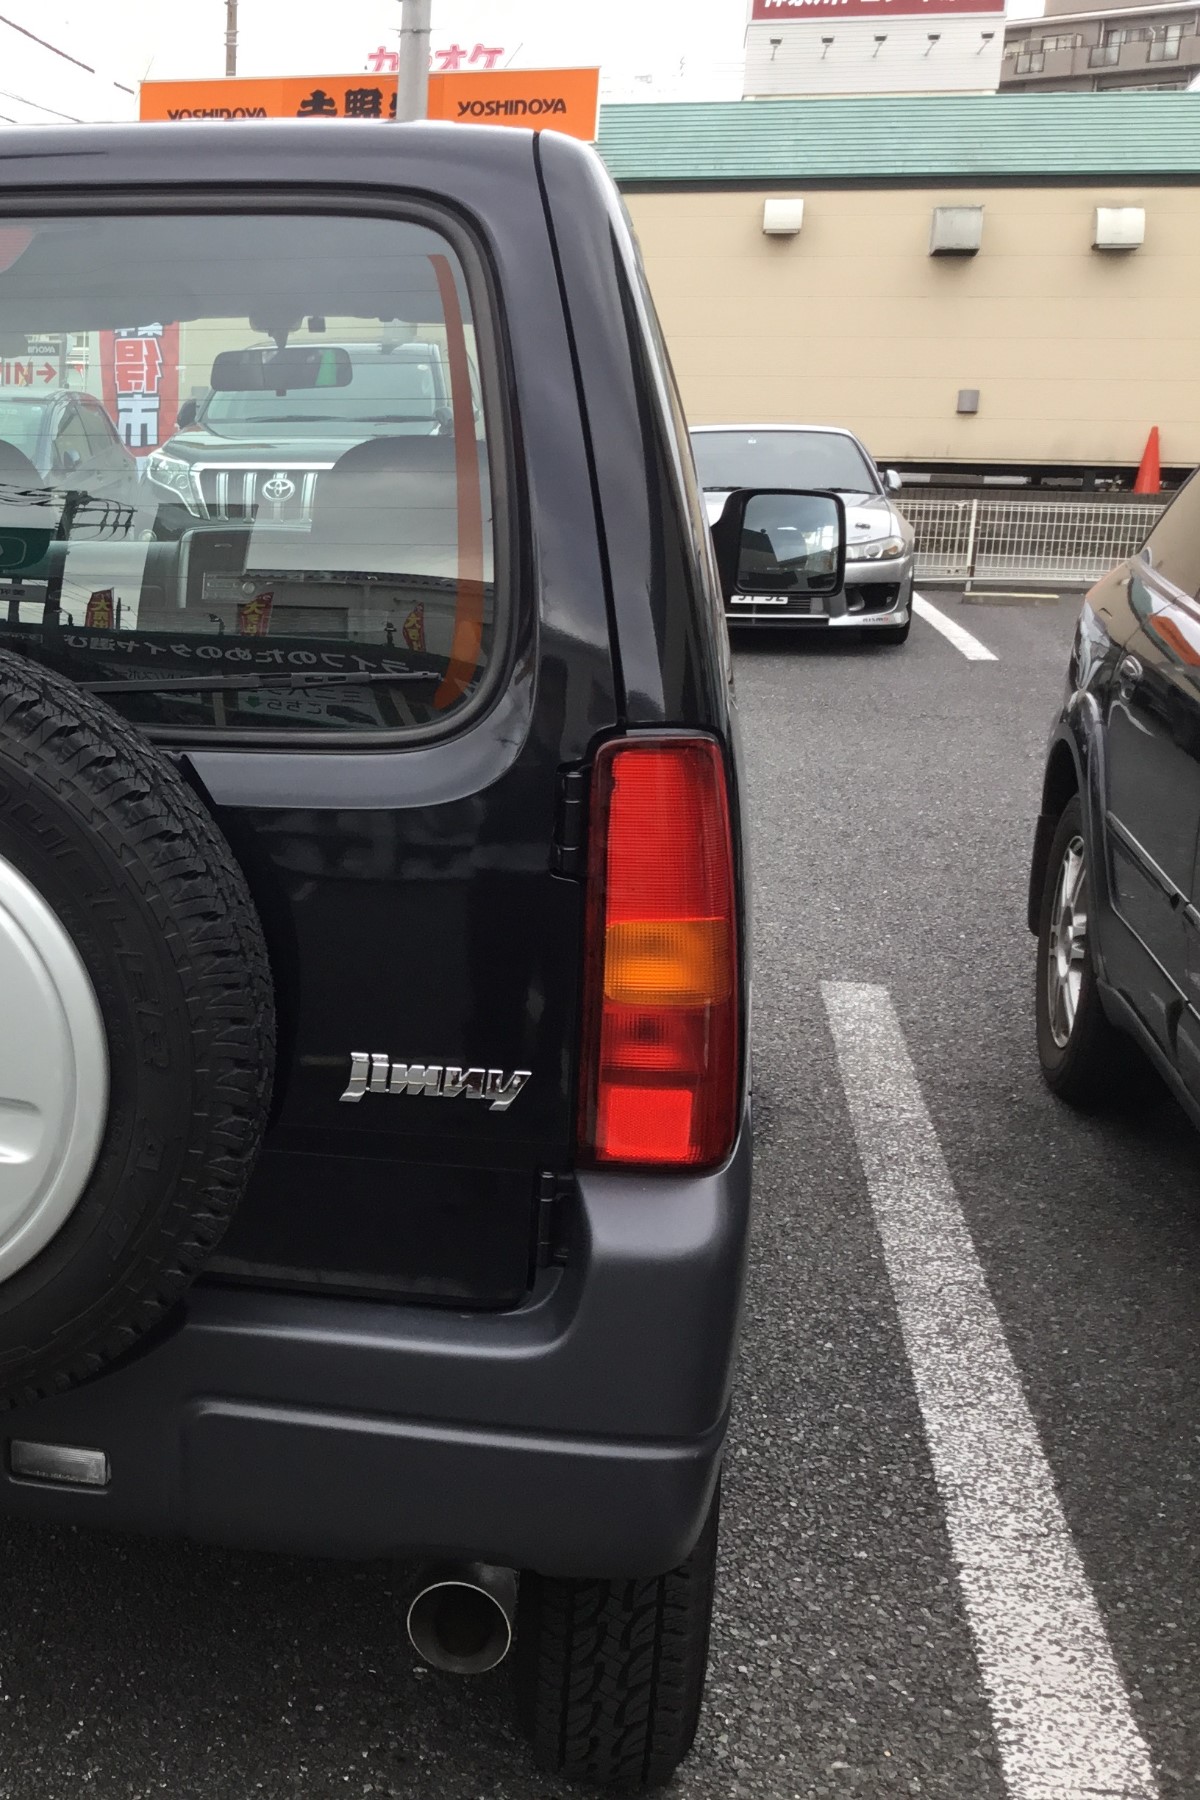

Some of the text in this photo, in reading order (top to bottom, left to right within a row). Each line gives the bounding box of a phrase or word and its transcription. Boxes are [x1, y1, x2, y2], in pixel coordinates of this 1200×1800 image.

[368, 43, 504, 71] カオケ
[297, 88, 397, 118] 吉野
[456, 97, 567, 117] YOSHINOYA
[5, 362, 33, 384] IN
